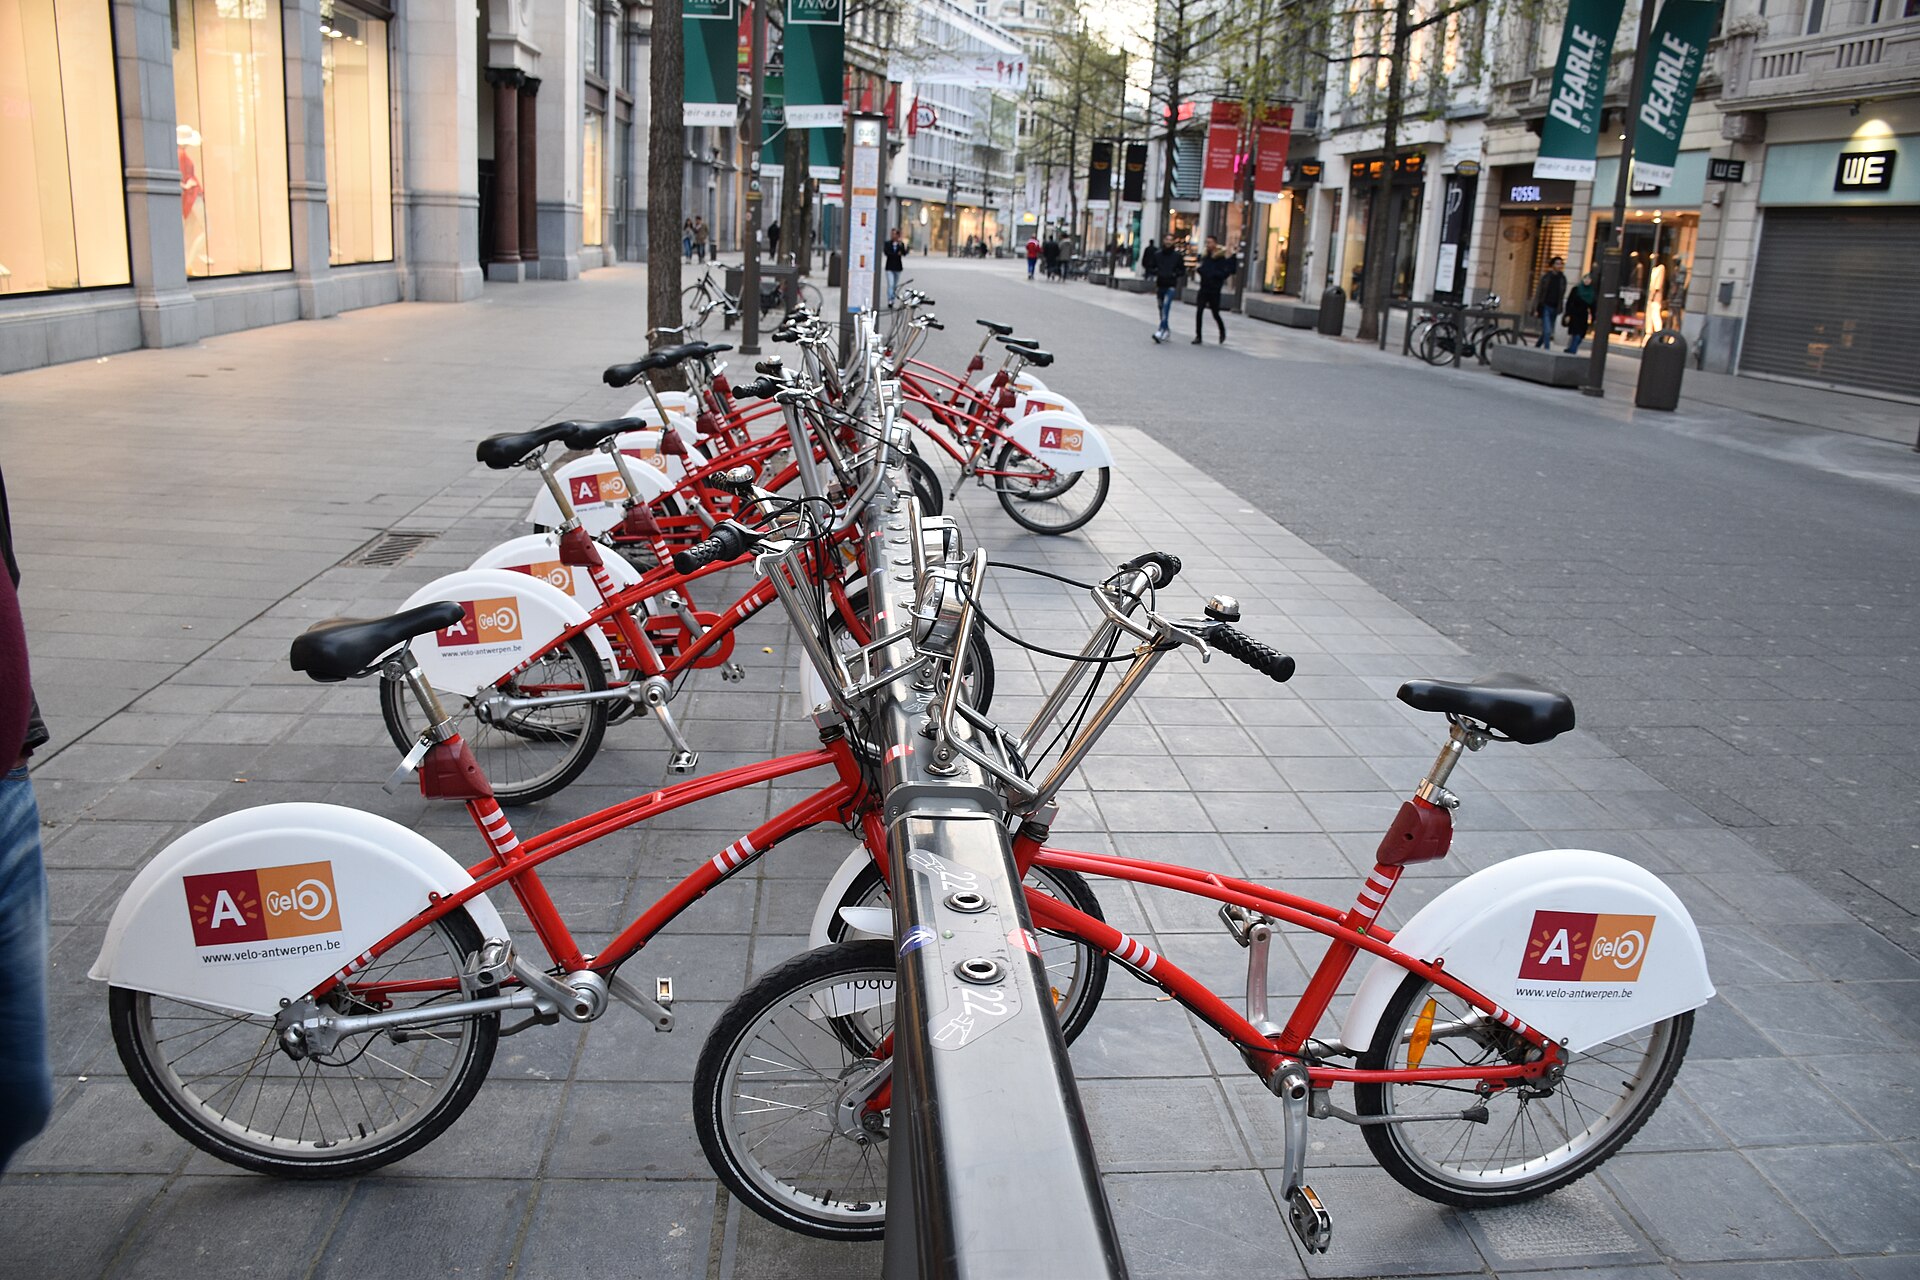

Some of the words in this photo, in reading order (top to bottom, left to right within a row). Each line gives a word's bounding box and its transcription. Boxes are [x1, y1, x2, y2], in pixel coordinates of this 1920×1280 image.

[1550, 24, 1599, 130] PEARLE
[1580, 37, 1607, 134] OPTICIENS
[1640, 31, 1690, 135] PEARLE
[1666, 45, 1699, 141] OPTICIENS
[684, 108, 733, 118] eir-as.be
[1714, 164, 1741, 178] WE
[1842, 156, 1886, 185] WE
[1510, 186, 1541, 202] FOSSIL
[1044, 431, 1057, 445] A
[578, 481, 594, 499] A
[441, 644, 523, 658] www.velo-antwerpen.be
[210, 889, 247, 929] A
[202, 939, 341, 964] www.velo-antwerpen.be
[1538, 928, 1571, 966] A
[961, 987, 1008, 1016] 22
[1515, 987, 1633, 1000] www.velo-antwerpen.be
